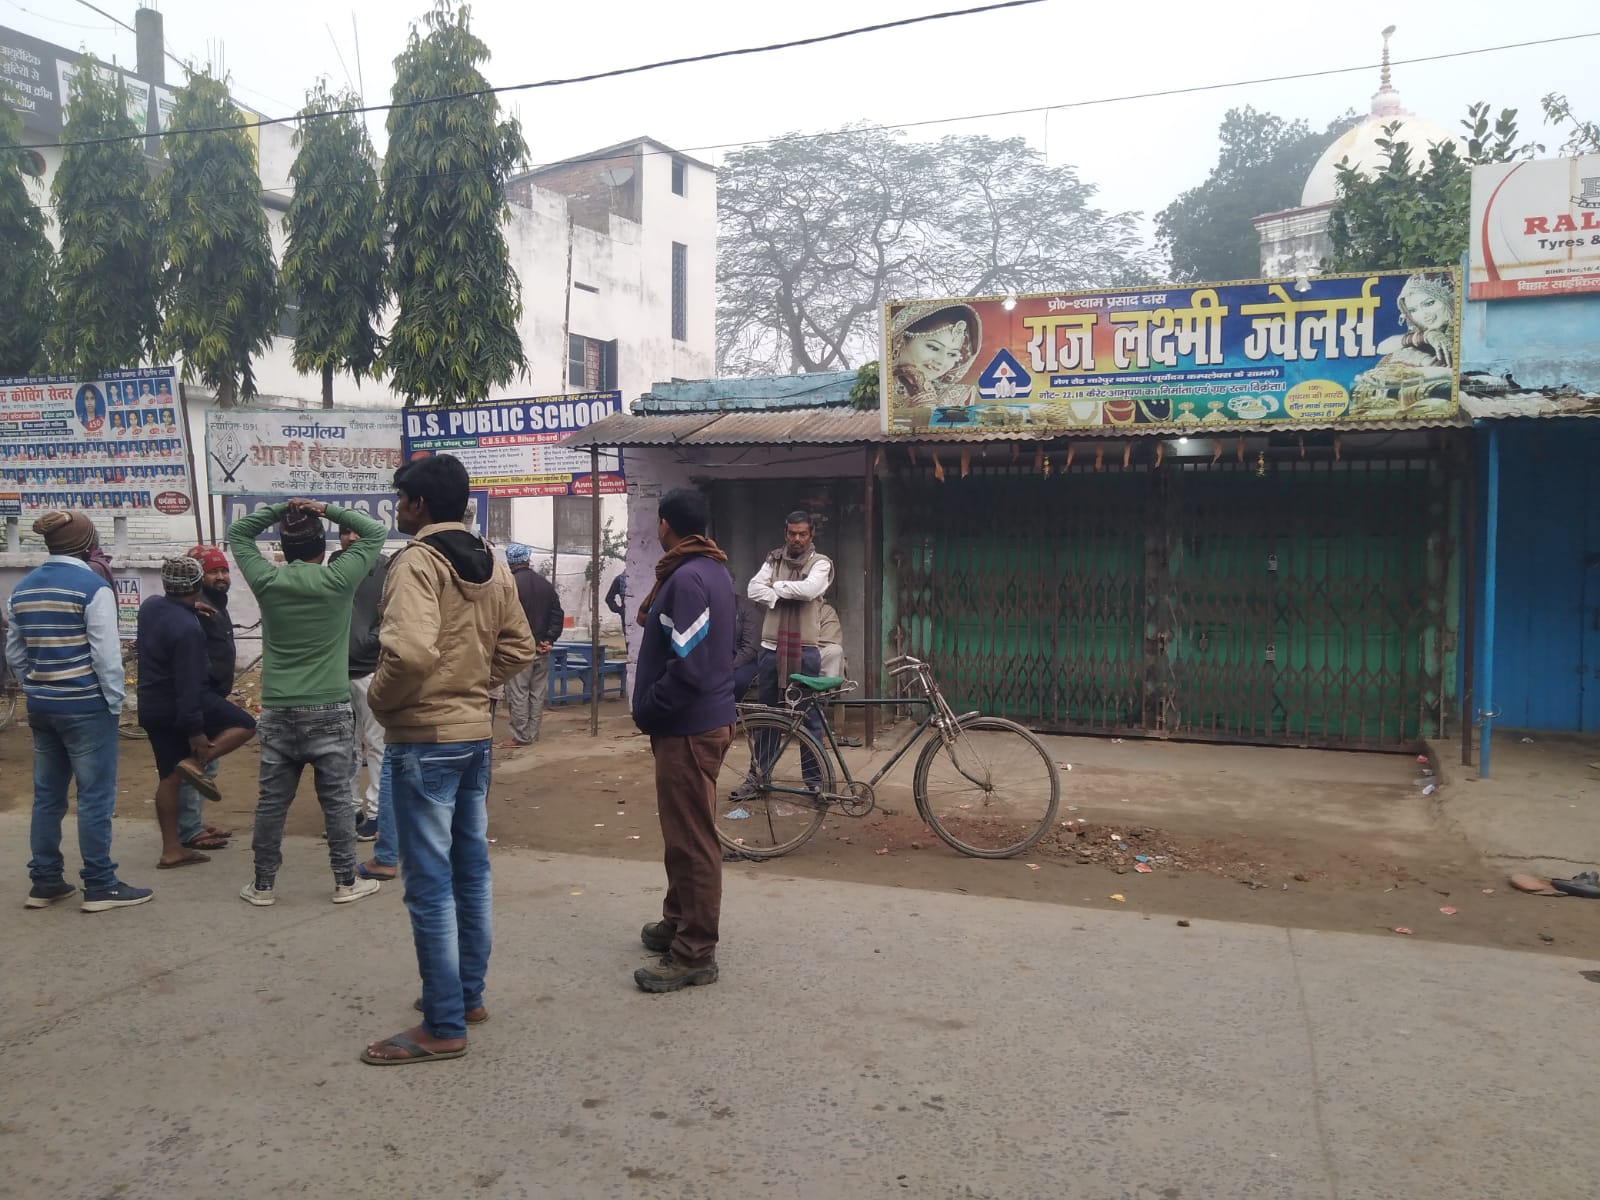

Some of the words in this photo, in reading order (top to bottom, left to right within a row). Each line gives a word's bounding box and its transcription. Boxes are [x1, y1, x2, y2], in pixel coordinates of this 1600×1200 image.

[1538, 238, 1585, 250] Tyres
[1107, 296, 1140, 308] प्रसाद
[1142, 294, 1167, 305] दास
[1023, 313, 1097, 372] राज
[1110, 288, 1229, 369] लक्ष्मी
[1240, 277, 1381, 361] ज्वेलर्स
[1234, 370, 1245, 378] के
[10, 385, 44, 402] कोचिंग
[1108, 388, 1142, 400] आभूषण
[1144, 387, 1157, 396] का
[1160, 383, 1192, 396] निर्माता
[1194, 383, 1209, 394] एवं
[1211, 385, 1226, 395] ग्रह
[1229, 384, 1248, 393] रत्न
[281, 422, 347, 440] कार्यालय
[407, 413, 445, 438] D.S.
[449, 407, 525, 435] PUBLIC
[518, 434, 536, 443] Bihar
[538, 433, 558, 442] Board
[250, 441, 304, 467] आर्मी
